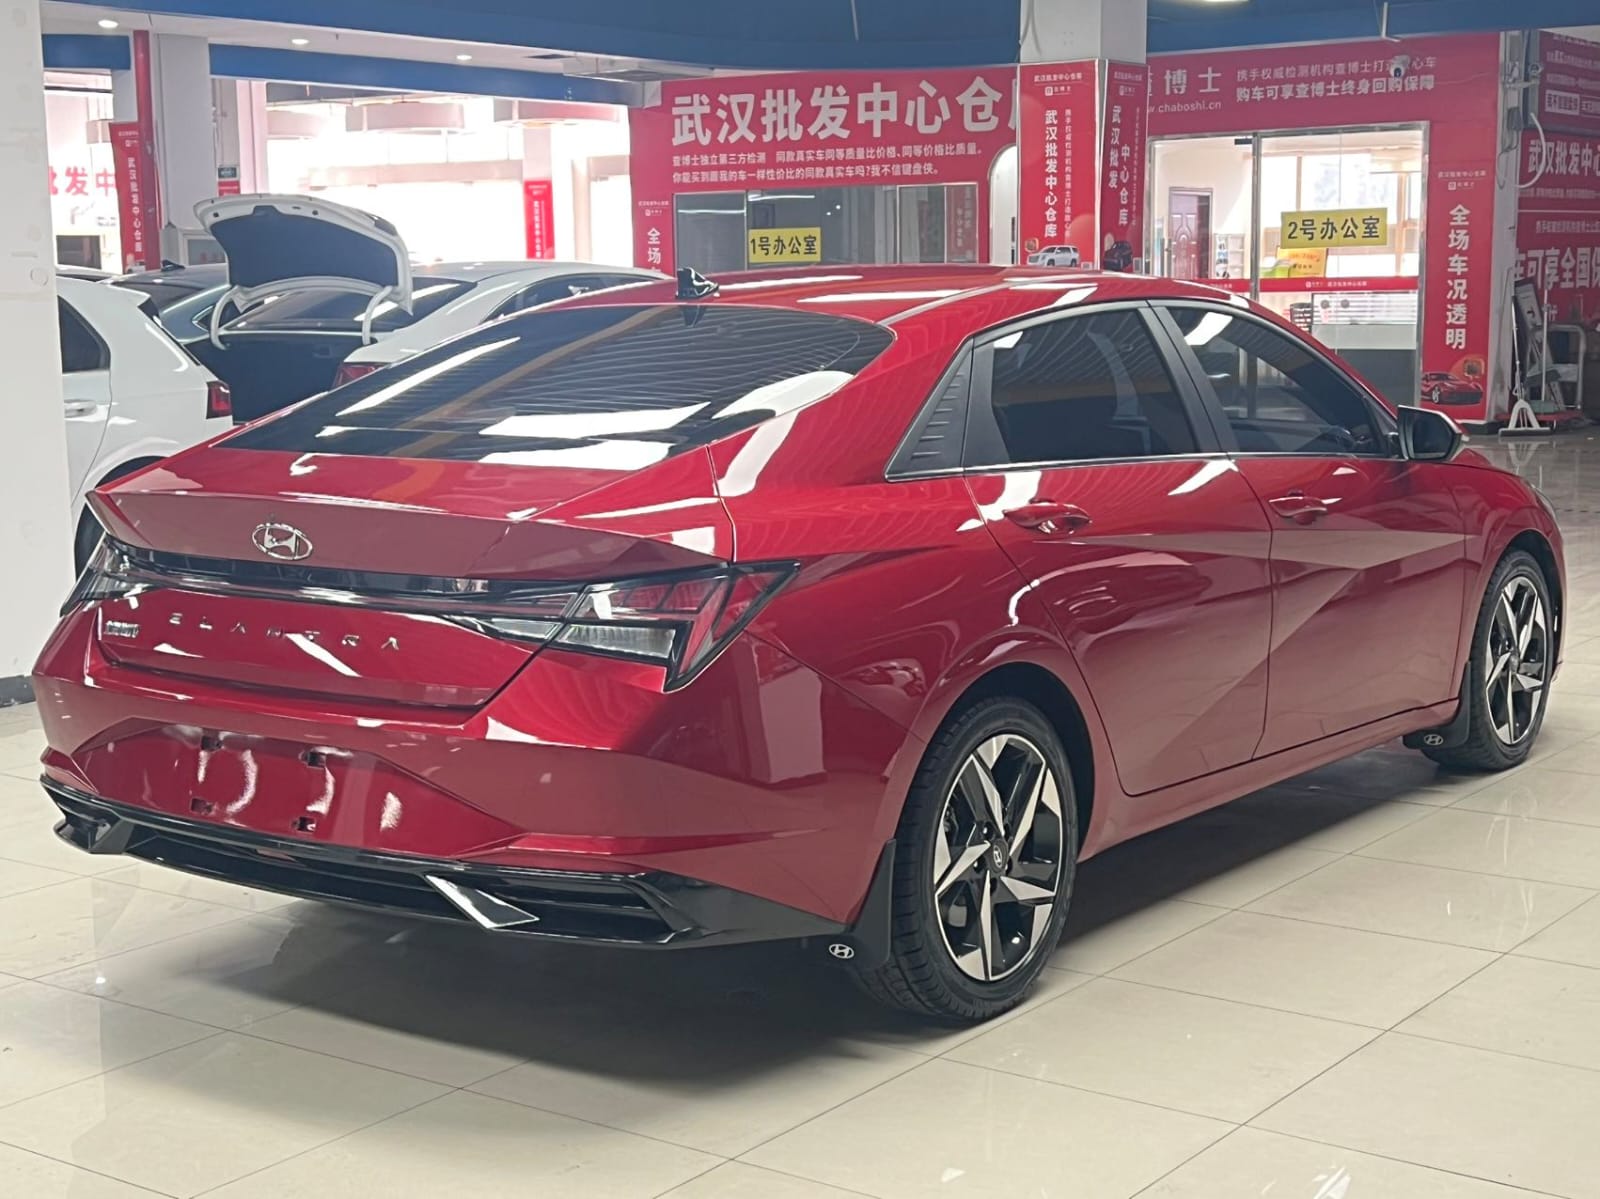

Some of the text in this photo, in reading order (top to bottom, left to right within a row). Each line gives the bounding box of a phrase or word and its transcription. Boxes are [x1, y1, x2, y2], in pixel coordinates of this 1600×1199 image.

[1148, 65, 1222, 97] 博士
[1236, 74, 1435, 102] 购车可享查博士终身回购保障
[671, 75, 1018, 147] 武汉批发中心仓
[1044, 109, 1058, 238] 武汉批发中心仓库
[1288, 216, 1380, 241] 2号办公室
[750, 235, 817, 256] 1号办公室
[1445, 204, 1471, 350] 全场车况透明
